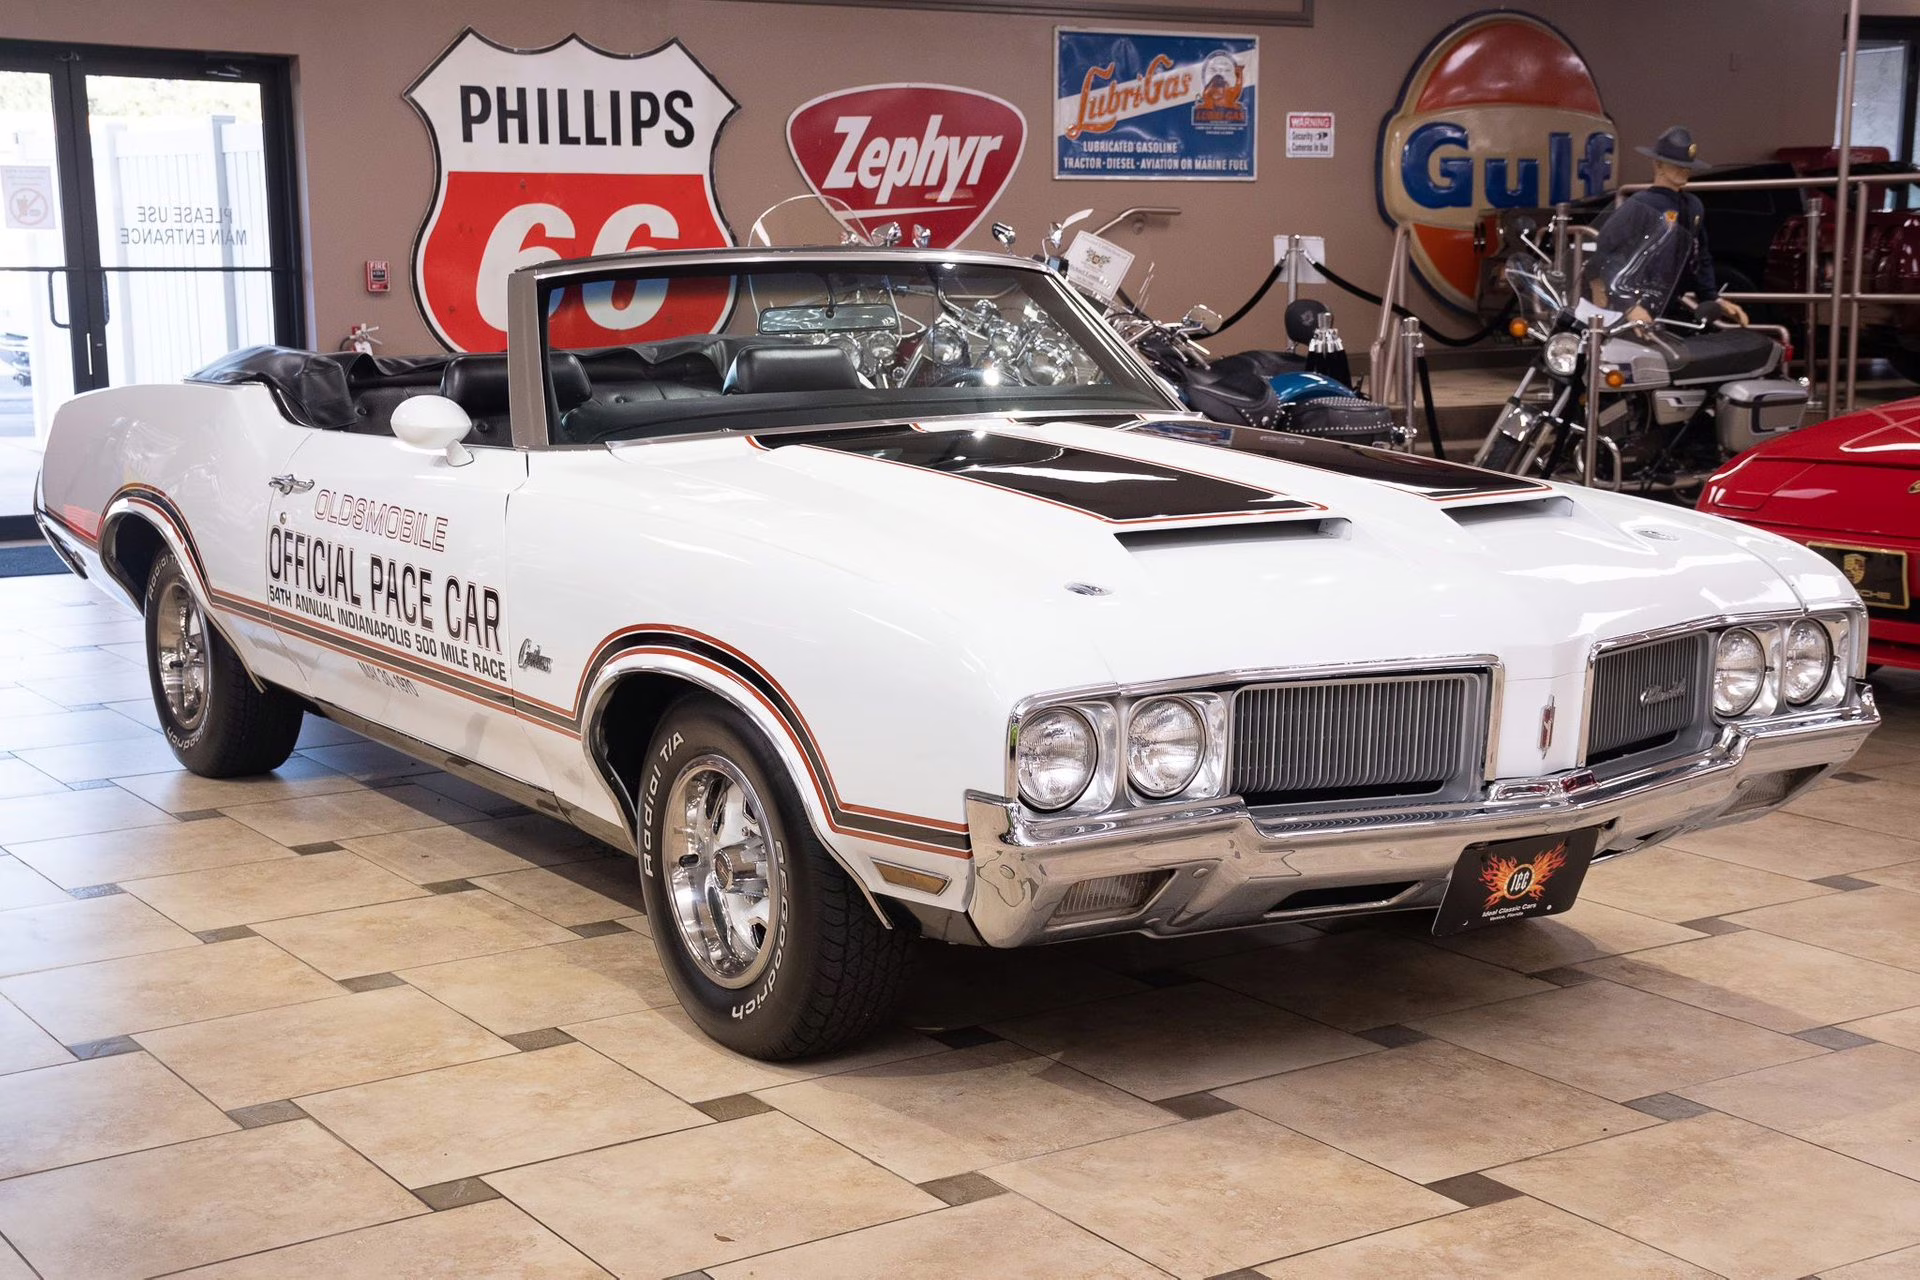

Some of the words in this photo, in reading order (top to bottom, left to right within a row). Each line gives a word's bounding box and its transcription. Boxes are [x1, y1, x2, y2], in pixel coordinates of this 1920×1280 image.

[460, 85, 695, 148] PHILLIPS
[1082, 141, 1134, 154] LUBRICATED
[1135, 142, 1178, 154] GASOLINE
[1291, 117, 1330, 128] WARNING
[821, 114, 1004, 205] Zephyr
[1063, 157, 1102, 169] TRACTOR
[1106, 157, 1136, 170] DIESEL
[1139, 157, 1180, 170] AVIATION
[1181, 158, 1193, 170] OR
[1194, 158, 1228, 171] MARINE
[1228, 158, 1249, 171] FUEL
[1401, 121, 1615, 209] Gulf
[475, 203, 680, 331] 66
[314, 489, 449, 552] OLDSMOBILE
[147, 555, 169, 600] Radial
[269, 524, 362, 609] OFFICIAL
[370, 553, 434, 632] PACE
[445, 575, 503, 655] CAR
[269, 585, 292, 608] 54TH
[295, 593, 335, 623] ANNUAL
[336, 607, 411, 649] INDIANAPOLIS
[415, 633, 437, 657] 500
[440, 641, 469, 670] MILE
[473, 652, 507, 682] RACE
[658, 731, 685, 763] T/A
[643, 764, 662, 878] Radial
[1481, 909, 1498, 918] Ideal
[1498, 906, 1521, 914] Classic
[1509, 870, 1531, 893] ICC
